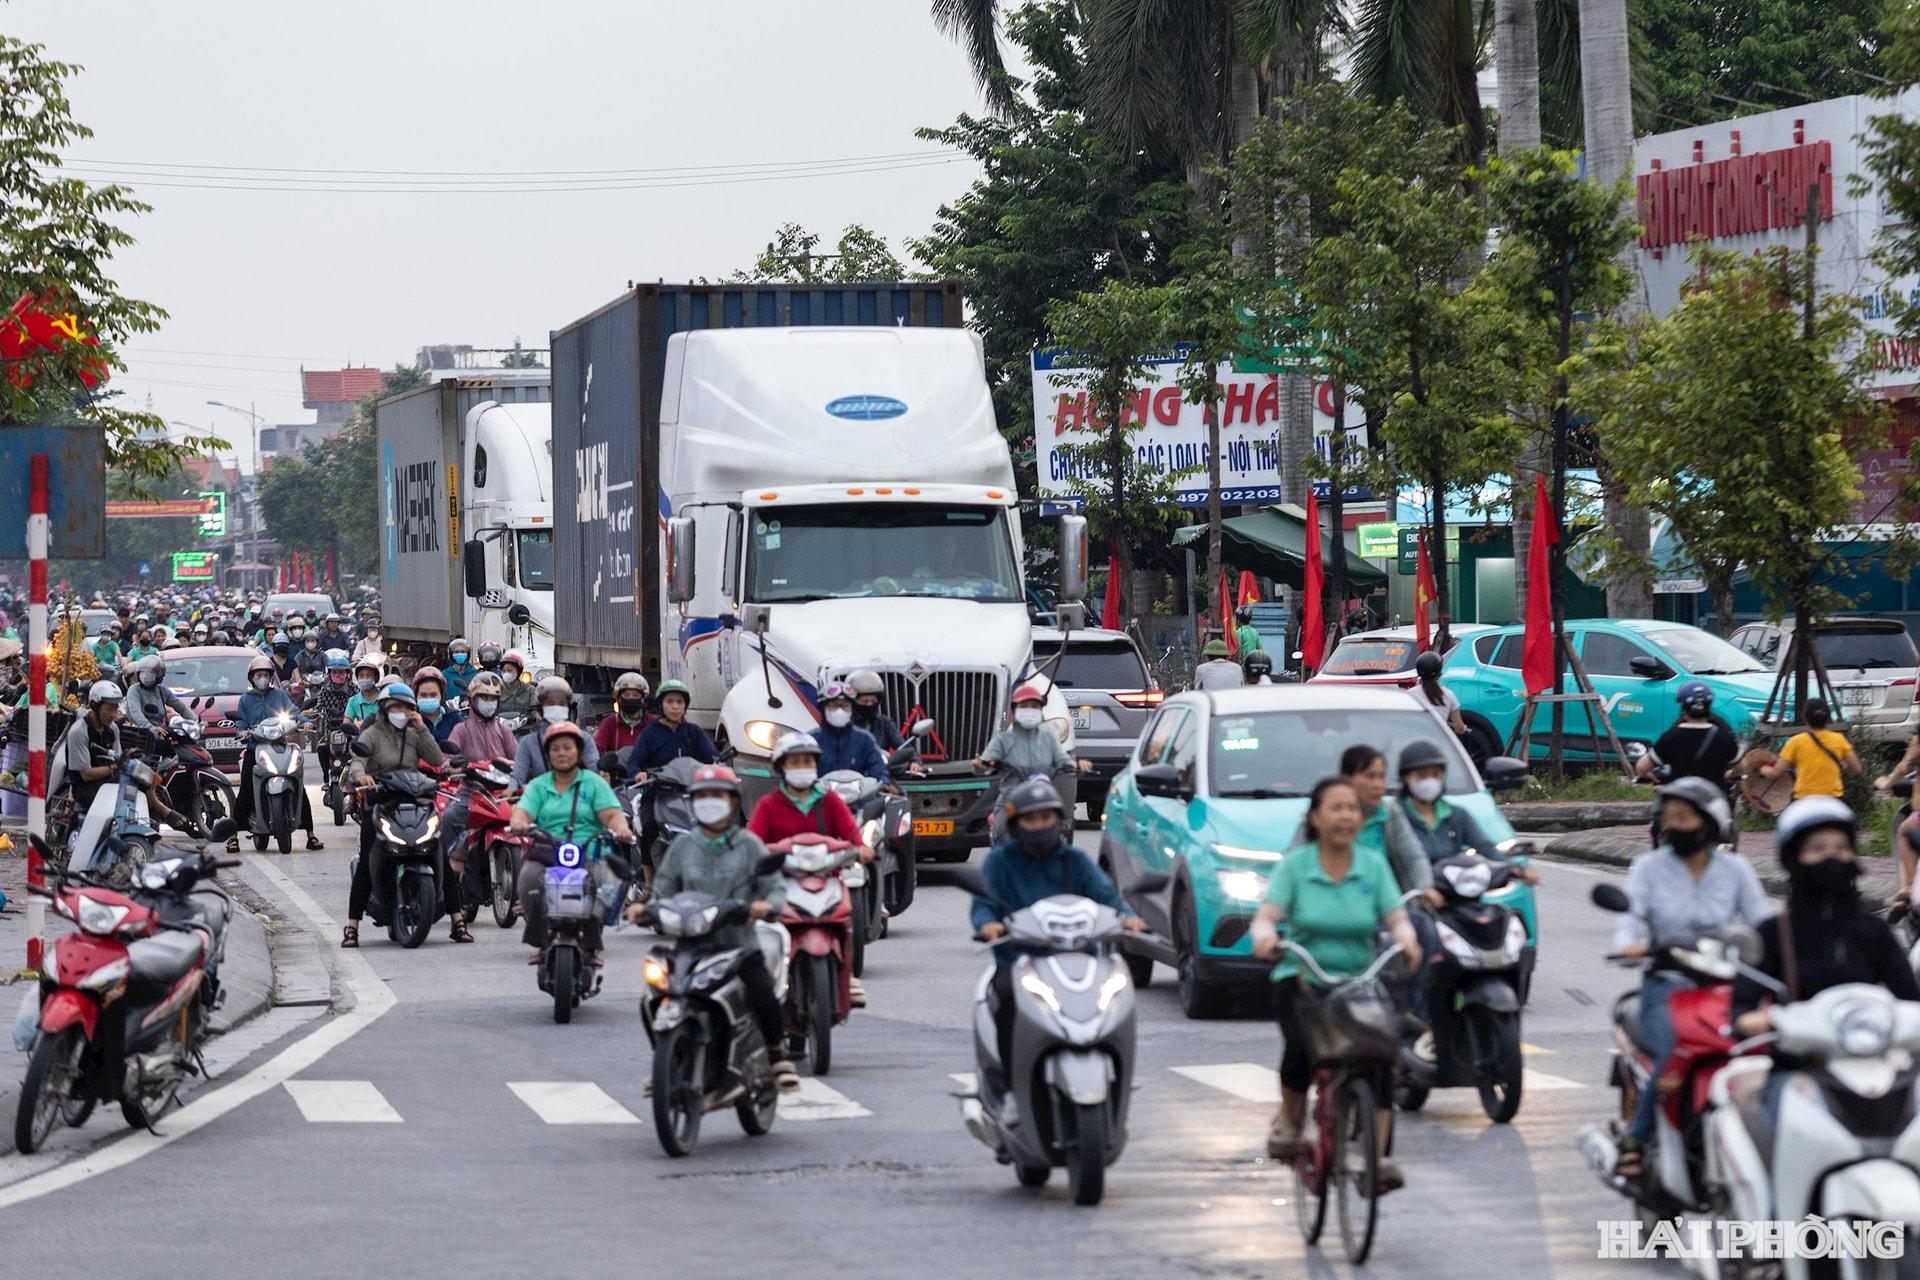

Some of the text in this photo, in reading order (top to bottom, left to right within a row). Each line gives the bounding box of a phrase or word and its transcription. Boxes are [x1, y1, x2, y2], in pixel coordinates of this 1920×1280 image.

[1228, 434, 1251, 478] NỘI
[1253, 429, 1281, 471] THẤ
[395, 461, 440, 552] MAERSK
